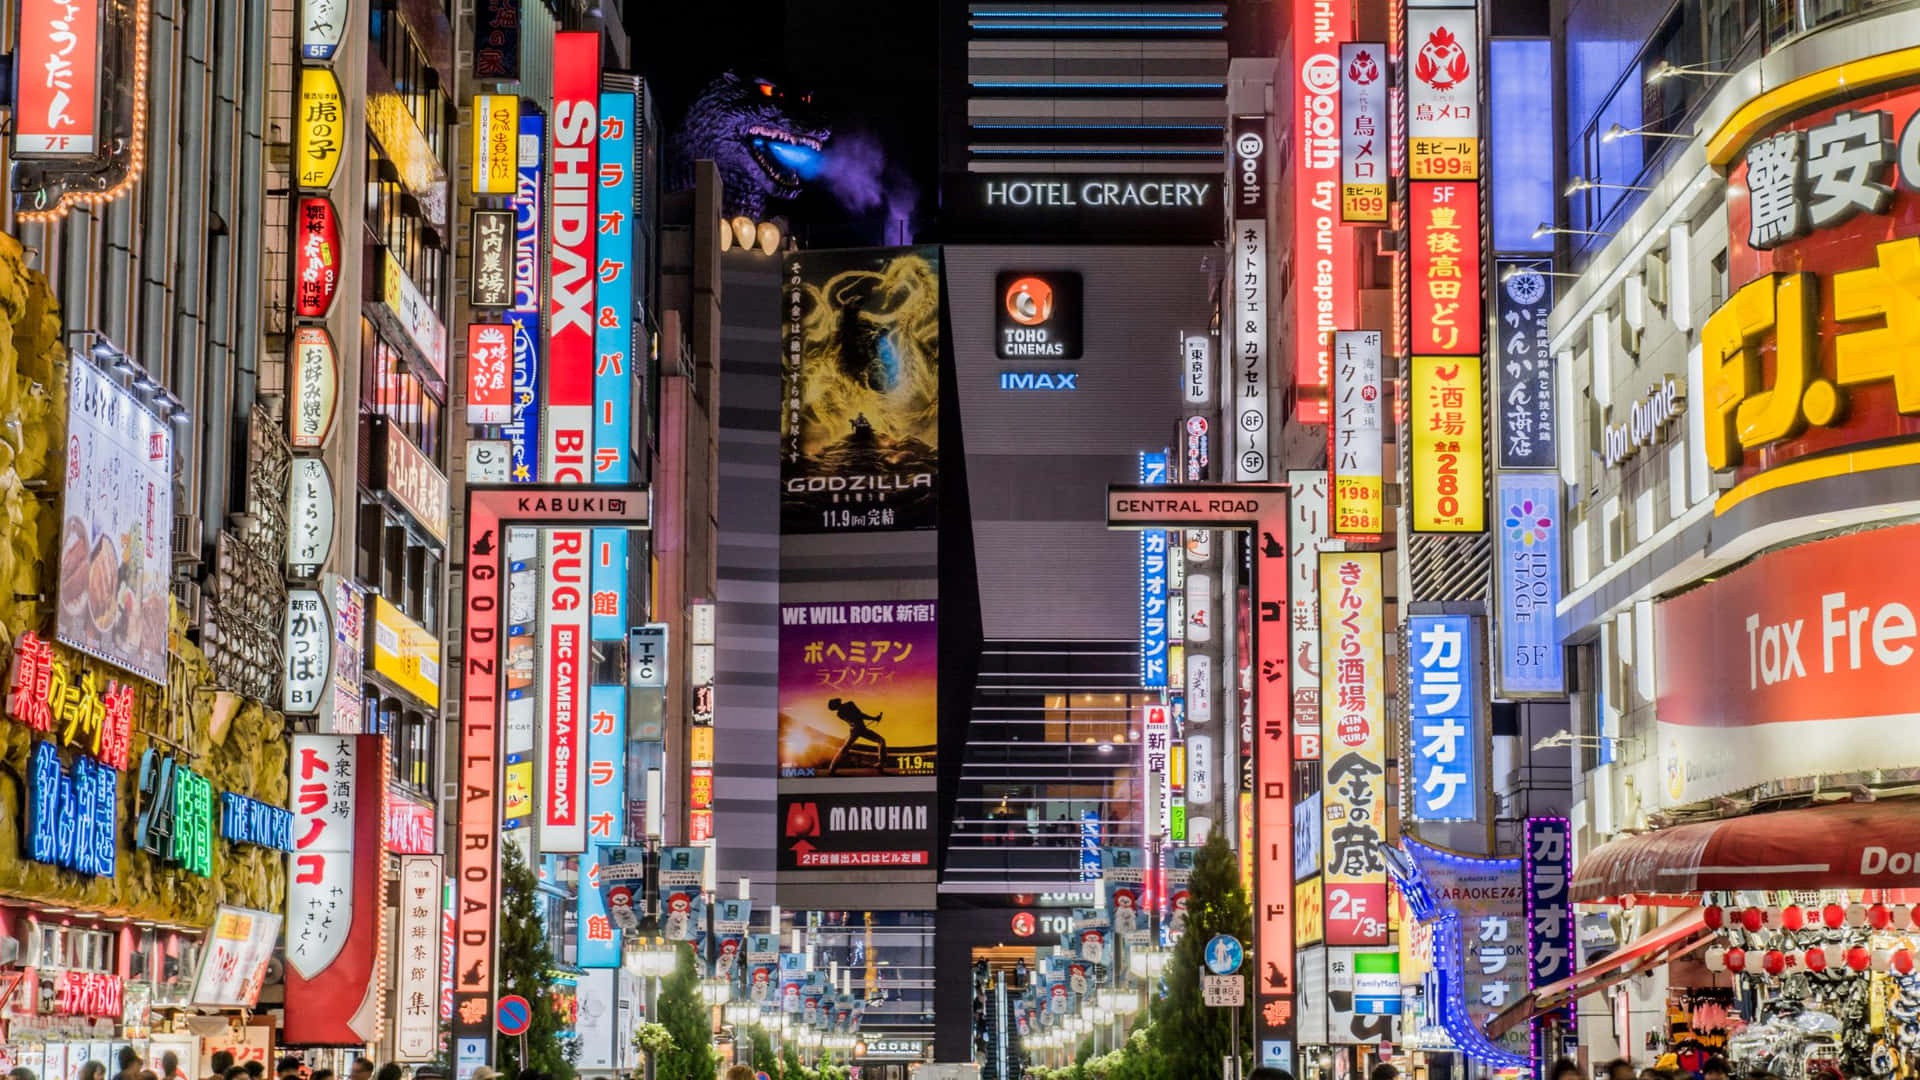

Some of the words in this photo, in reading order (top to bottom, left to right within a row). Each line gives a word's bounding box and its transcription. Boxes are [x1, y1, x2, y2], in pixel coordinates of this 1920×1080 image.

[1314, 0, 1335, 44] rink
[45, 0, 80, 129] ょうたん
[310, 46, 329, 56] 5F
[305, 101, 337, 160] 虎の子
[1416, 104, 1471, 121] 鳥メロ
[45, 136, 70, 150] 7F
[1354, 115, 1375, 178] 鳥メロ
[1416, 142, 1471, 155] 生ビール
[303, 171, 324, 183] 4F
[986, 182, 1076, 206] HOTEL
[1081, 182, 1209, 206] GRACERY
[1312, 180, 1336, 211] try
[1346, 187, 1383, 196] 生ビール
[1433, 187, 1455, 203] 5F
[551, 100, 596, 337] SHIDAX
[1352, 197, 1383, 212] 199
[1317, 216, 1332, 254] our
[1426, 207, 1462, 349] 豊後高田どり
[1313, 259, 1337, 346] capsule
[1005, 329, 1047, 342] TOHO
[1005, 344, 1063, 355] CINEMAS
[1364, 335, 1379, 346] 4F
[593, 116, 625, 616] カラオケ&パーテー館
[1000, 372, 1077, 390] IMAX
[1191, 350, 1204, 397] 東京ビル
[303, 348, 322, 434] お好み焼き
[1245, 415, 1259, 426] 8F
[1430, 386, 1466, 436] 酒場
[1606, 419, 1628, 468] Don
[1630, 376, 1678, 441] Quijote
[1245, 457, 1260, 468] 5F
[1434, 441, 1460, 453] 全品
[788, 473, 932, 492] GODZILLA
[1436, 454, 1458, 517] 280
[302, 483, 319, 559] とらそば
[1116, 500, 1202, 512] CENTRAL
[1209, 500, 1258, 512] ROAD
[296, 565, 316, 577] 1F
[551, 532, 582, 611] RUG
[1514, 553, 1531, 622] STAGE
[1532, 553, 1548, 609] IDOL
[291, 600, 317, 611] 新宿
[782, 607, 808, 625] WE
[810, 605, 847, 625] WILL
[850, 605, 894, 624] ROCK
[896, 604, 935, 622] 新宿!
[1146, 534, 1166, 679] カラオケランド
[290, 613, 317, 682] かっぱ
[558, 630, 573, 658] BIC
[803, 640, 913, 664] ボヘミアン
[1338, 562, 1366, 712] きんくら酒場
[1516, 645, 1548, 666] 5F
[1746, 613, 1807, 690] Tax
[291, 690, 313, 703] B1
[466, 565, 495, 803] GODZILLA
[815, 666, 896, 689] ラプソディ
[1420, 624, 1466, 811] カラオケ
[782, 767, 816, 777] IMAX
[897, 756, 922, 769] 11.9
[1149, 733, 1166, 773] 新宿
[1261, 600, 1286, 921] ゴジラロード
[331, 740, 352, 819] 大衆酒場
[35, 742, 118, 877] 飲み放題
[296, 748, 329, 885] トラノコ
[829, 805, 928, 831] MARUHAN
[1327, 751, 1386, 878] 金の蔵
[462, 834, 489, 946] ROAD
[1328, 889, 1367, 920] 2F
[1534, 828, 1566, 978] カラオケ
[296, 898, 322, 956] やきとん
[317, 886, 343, 943] やきとり
[1806, 911, 1821, 923] 祭
[1356, 979, 1398, 989] FamilyMart
[1479, 916, 1510, 1024] カラオ
[866, 1041, 921, 1050] ACORN
